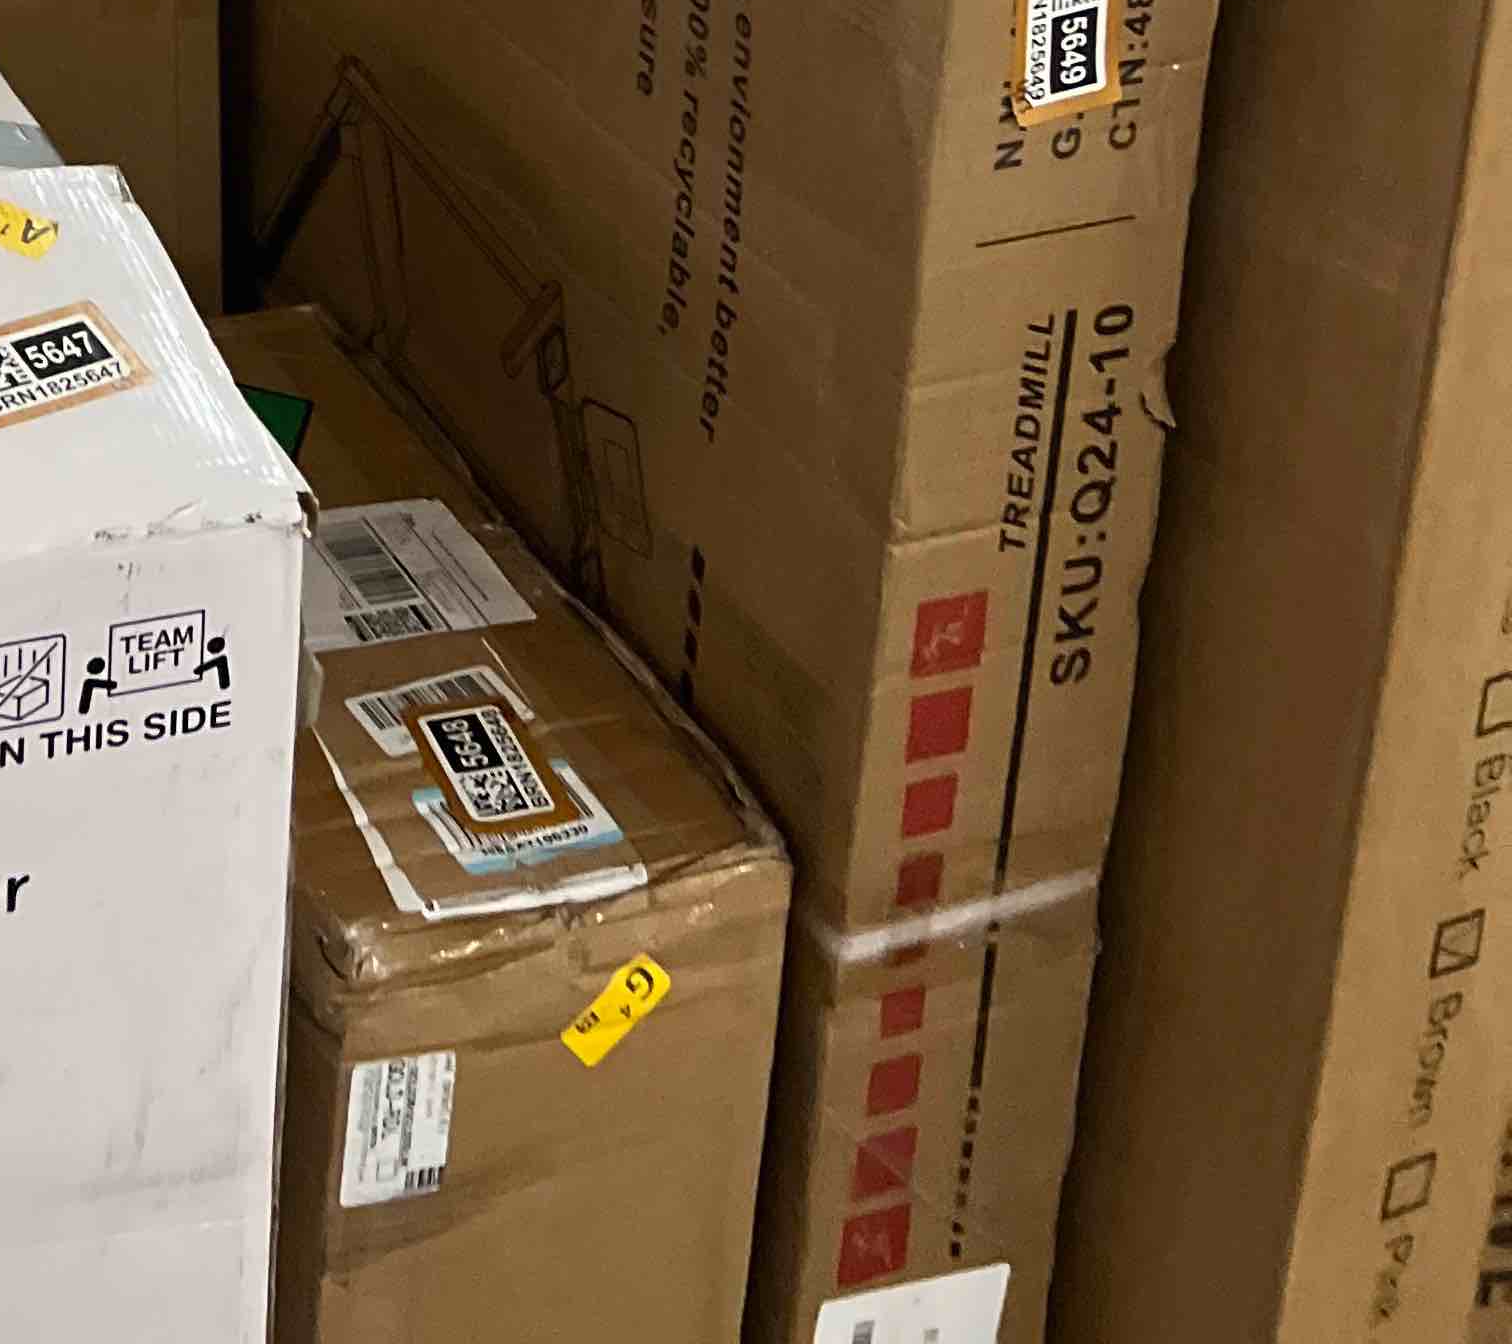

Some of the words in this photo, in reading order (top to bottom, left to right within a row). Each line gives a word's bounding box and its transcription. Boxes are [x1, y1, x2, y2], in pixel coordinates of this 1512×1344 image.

[1059, 15, 1089, 85] 5649
[26, 330, 96, 371] 5647
[699, 298, 738, 444] better
[998, 313, 1056, 553] TREADMILL
[1051, 303, 1135, 686] SKU:Q24-10
[119, 625, 195, 655] TEAM
[126, 648, 185, 676] LIFT
[45, 719, 131, 760] THIS
[142, 700, 233, 741] SIDE
[440, 718, 489, 769] 5648
[624, 965, 656, 1002] G
